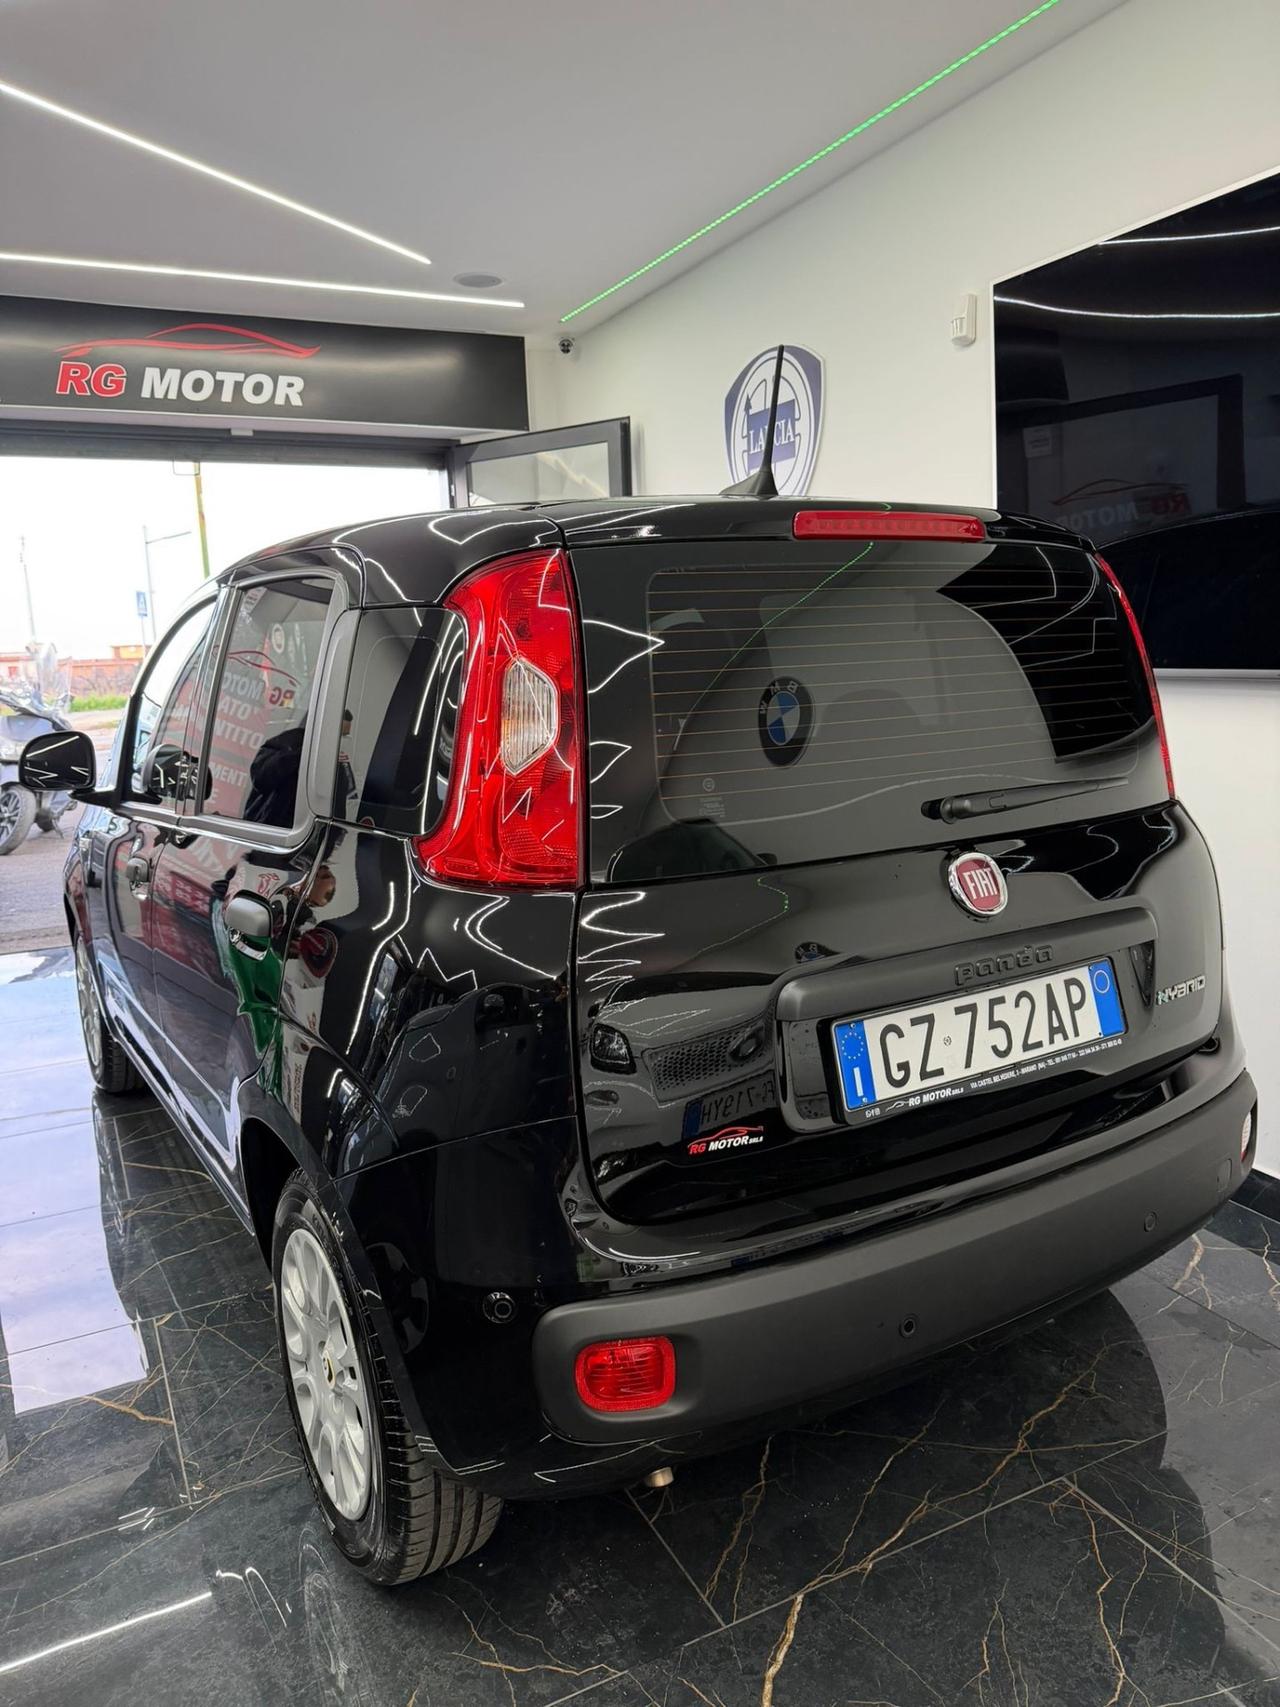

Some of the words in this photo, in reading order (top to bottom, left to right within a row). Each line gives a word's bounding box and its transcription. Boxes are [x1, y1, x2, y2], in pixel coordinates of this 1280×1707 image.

[56, 361, 127, 397] RG
[141, 367, 304, 406] MOTOR
[963, 867, 998, 900] FIAT
[1156, 975, 1206, 1006] HYBRID
[879, 1013, 945, 1088] GZ
[954, 977, 1086, 1069] 752AP
[908, 1096, 921, 1107] RG
[923, 1088, 952, 1103] MOTOR
[689, 1143, 707, 1155] RG
[708, 1135, 749, 1152] MOTOR
